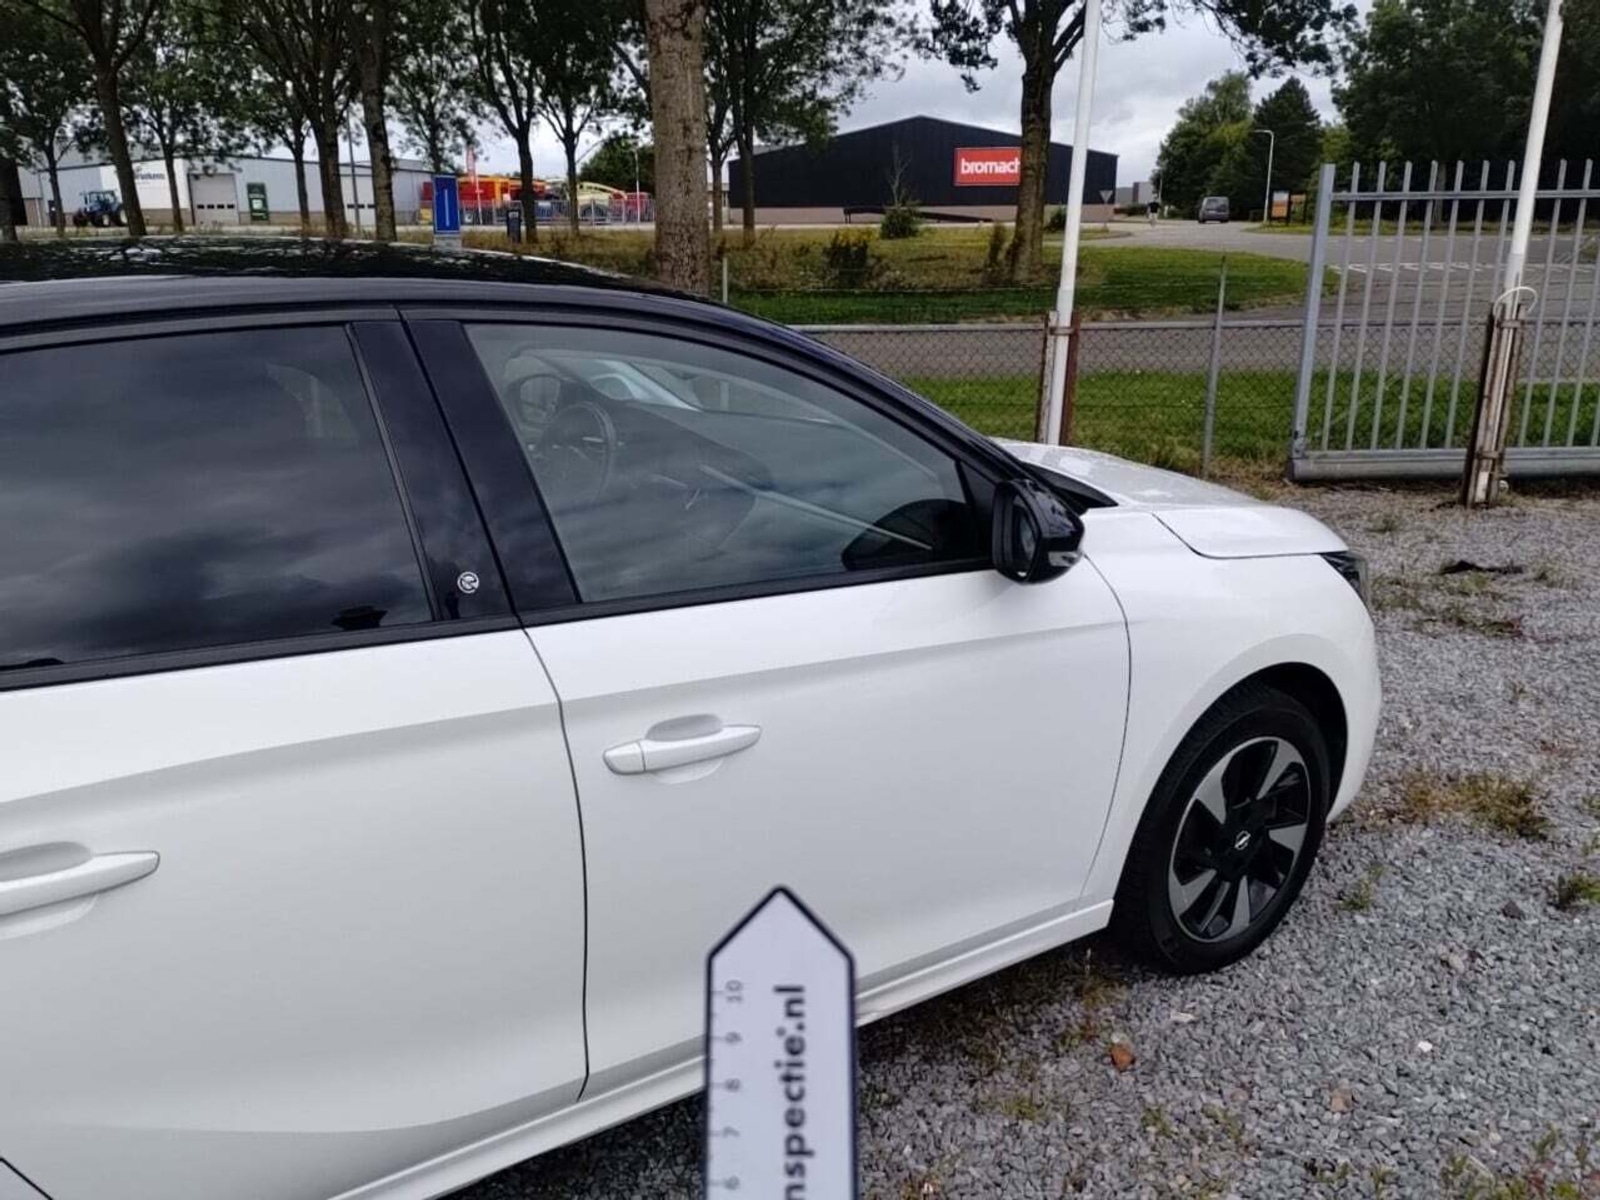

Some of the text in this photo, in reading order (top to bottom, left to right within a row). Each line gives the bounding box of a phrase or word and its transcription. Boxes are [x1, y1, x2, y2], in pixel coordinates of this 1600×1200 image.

[725, 979, 743, 1003] 10
[725, 1031, 742, 1044] 9
[724, 1077, 741, 1092] 8
[722, 1126, 740, 1138] 7
